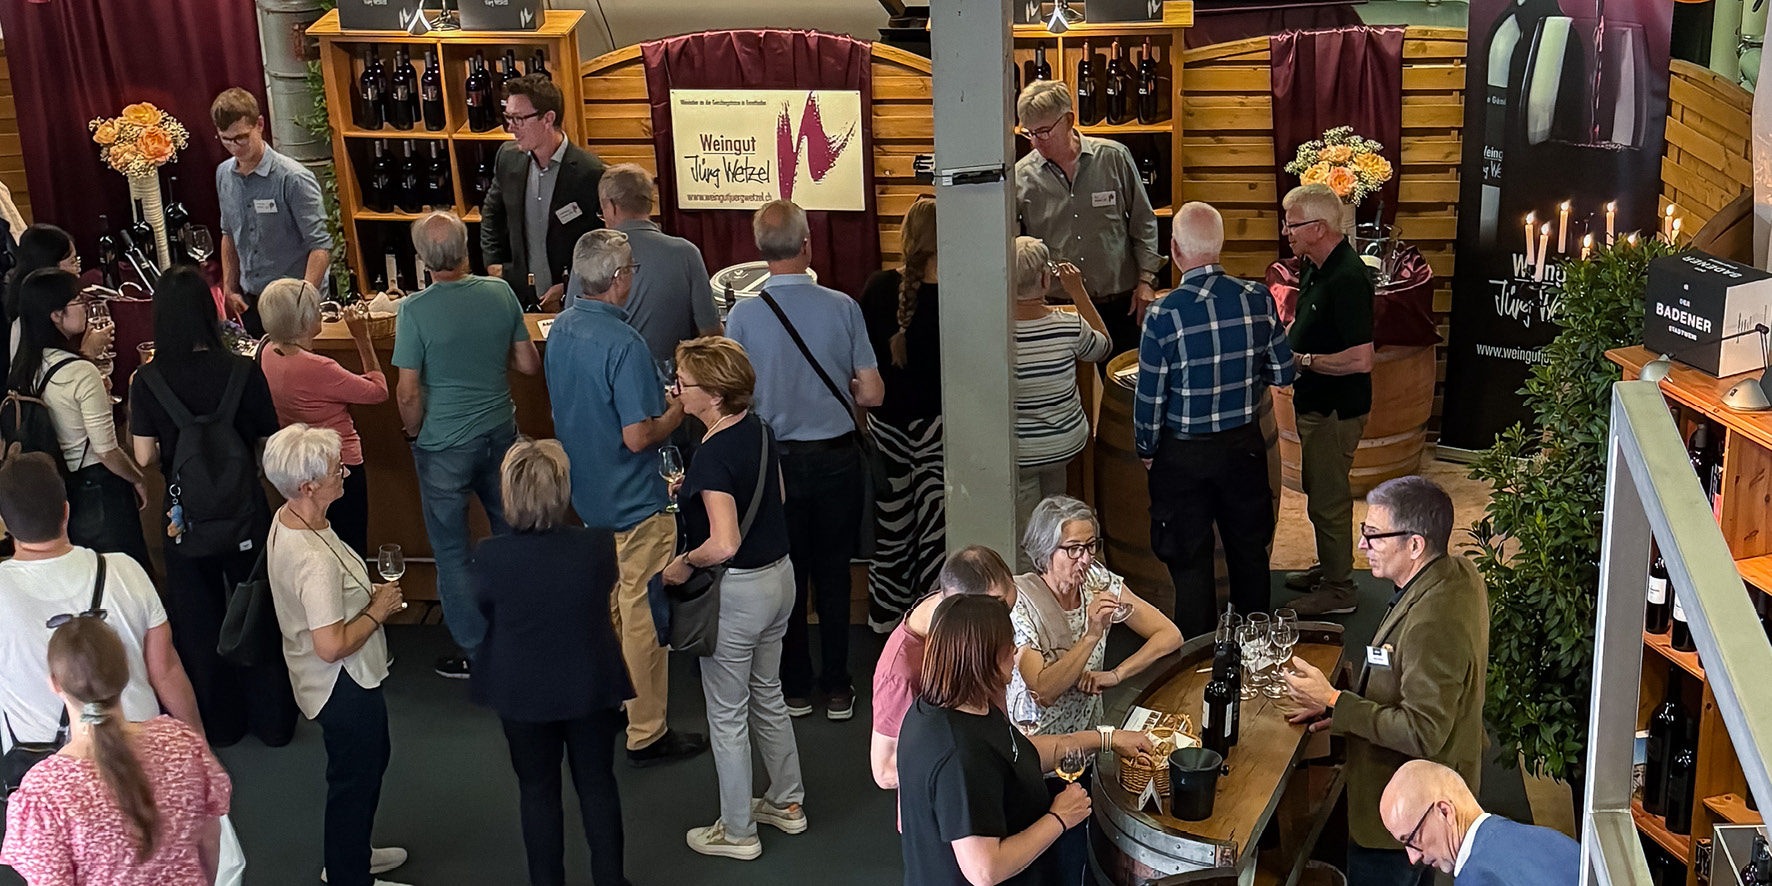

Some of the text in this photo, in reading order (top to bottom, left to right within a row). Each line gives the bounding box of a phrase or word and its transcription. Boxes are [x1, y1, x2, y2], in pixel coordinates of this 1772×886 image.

[700, 134, 756, 156] Weingut
[684, 155, 770, 189] Jürg Wetzel
[1655, 302, 1712, 334] BADENER
